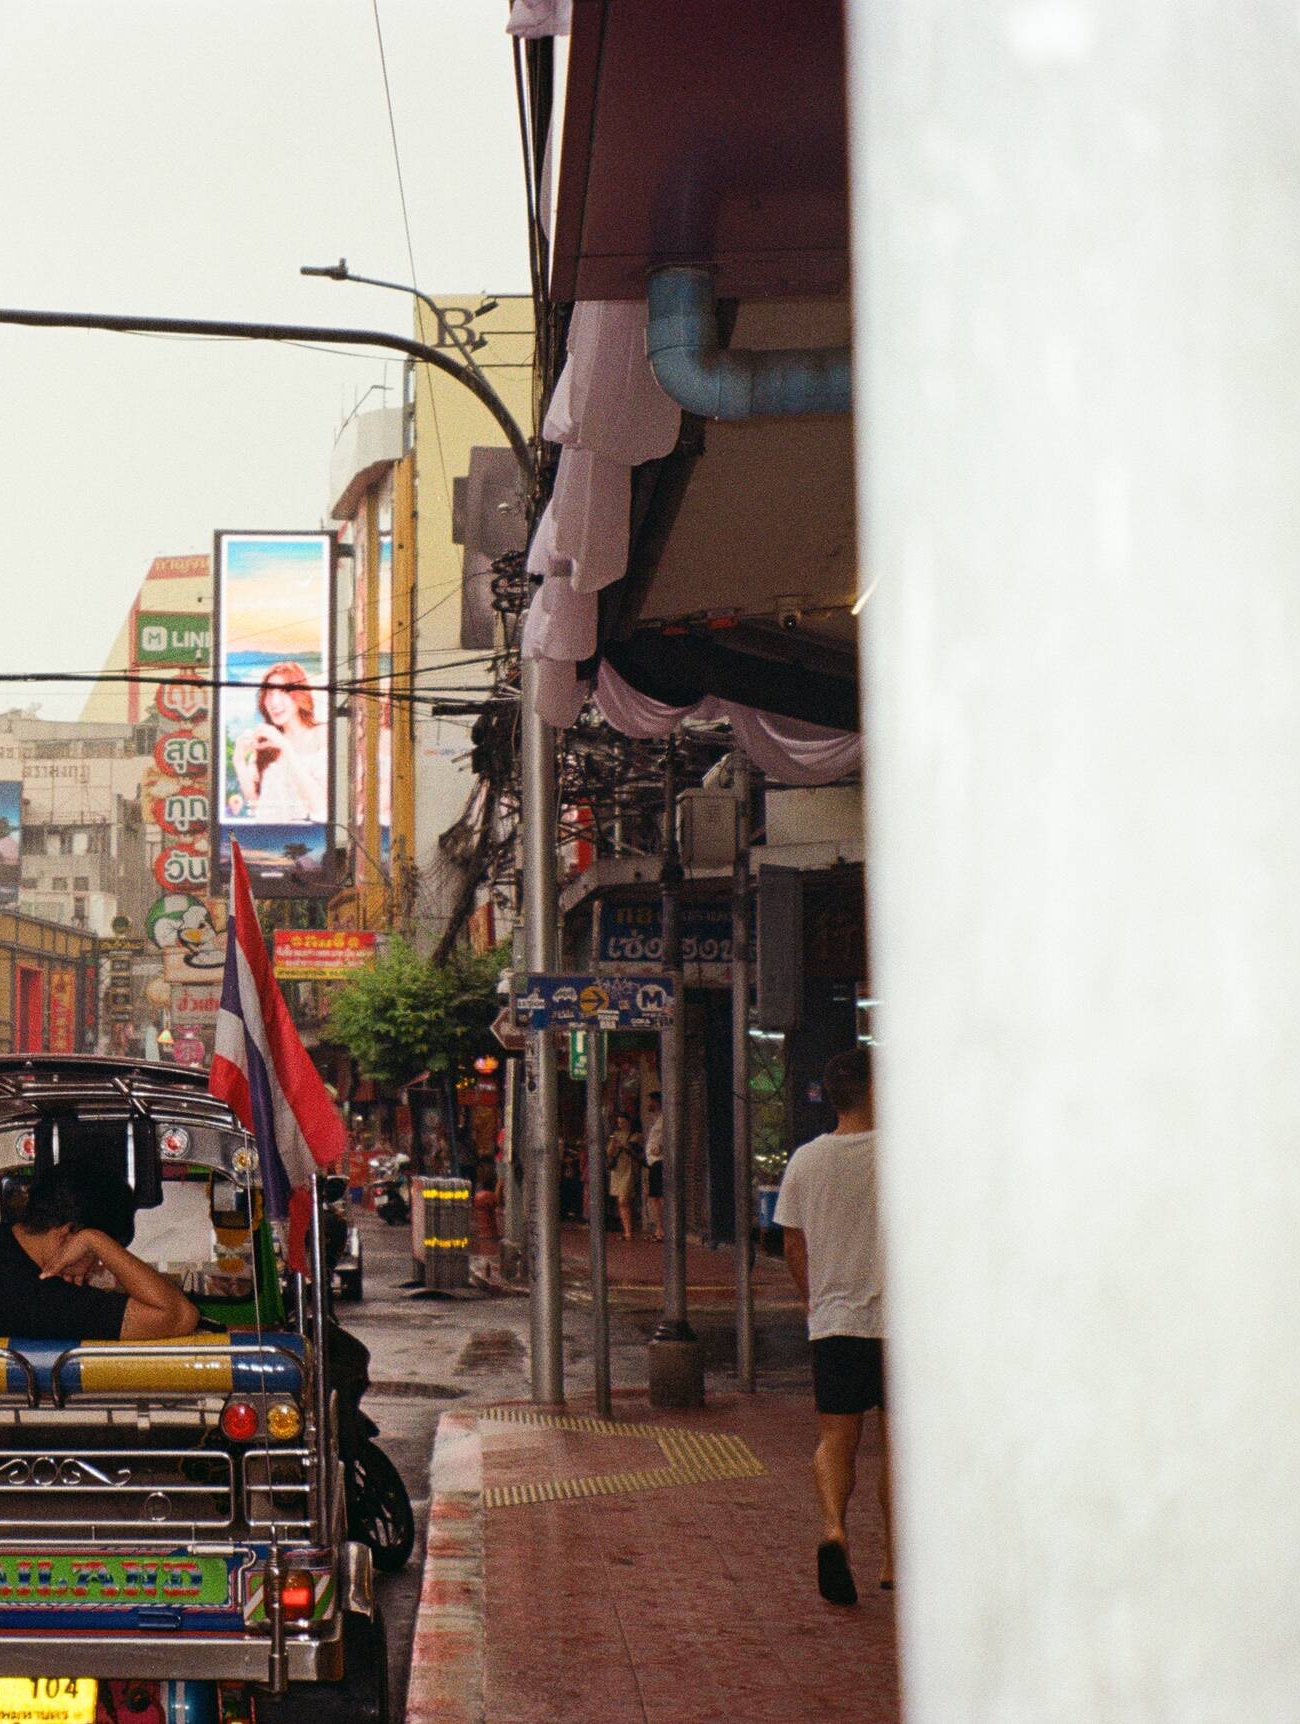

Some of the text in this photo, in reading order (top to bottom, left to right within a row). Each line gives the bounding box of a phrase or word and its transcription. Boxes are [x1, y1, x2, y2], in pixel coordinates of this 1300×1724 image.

[165, 738, 208, 772] สุด
[166, 852, 207, 881] วัน
[30, 1677, 78, 1700] 104
